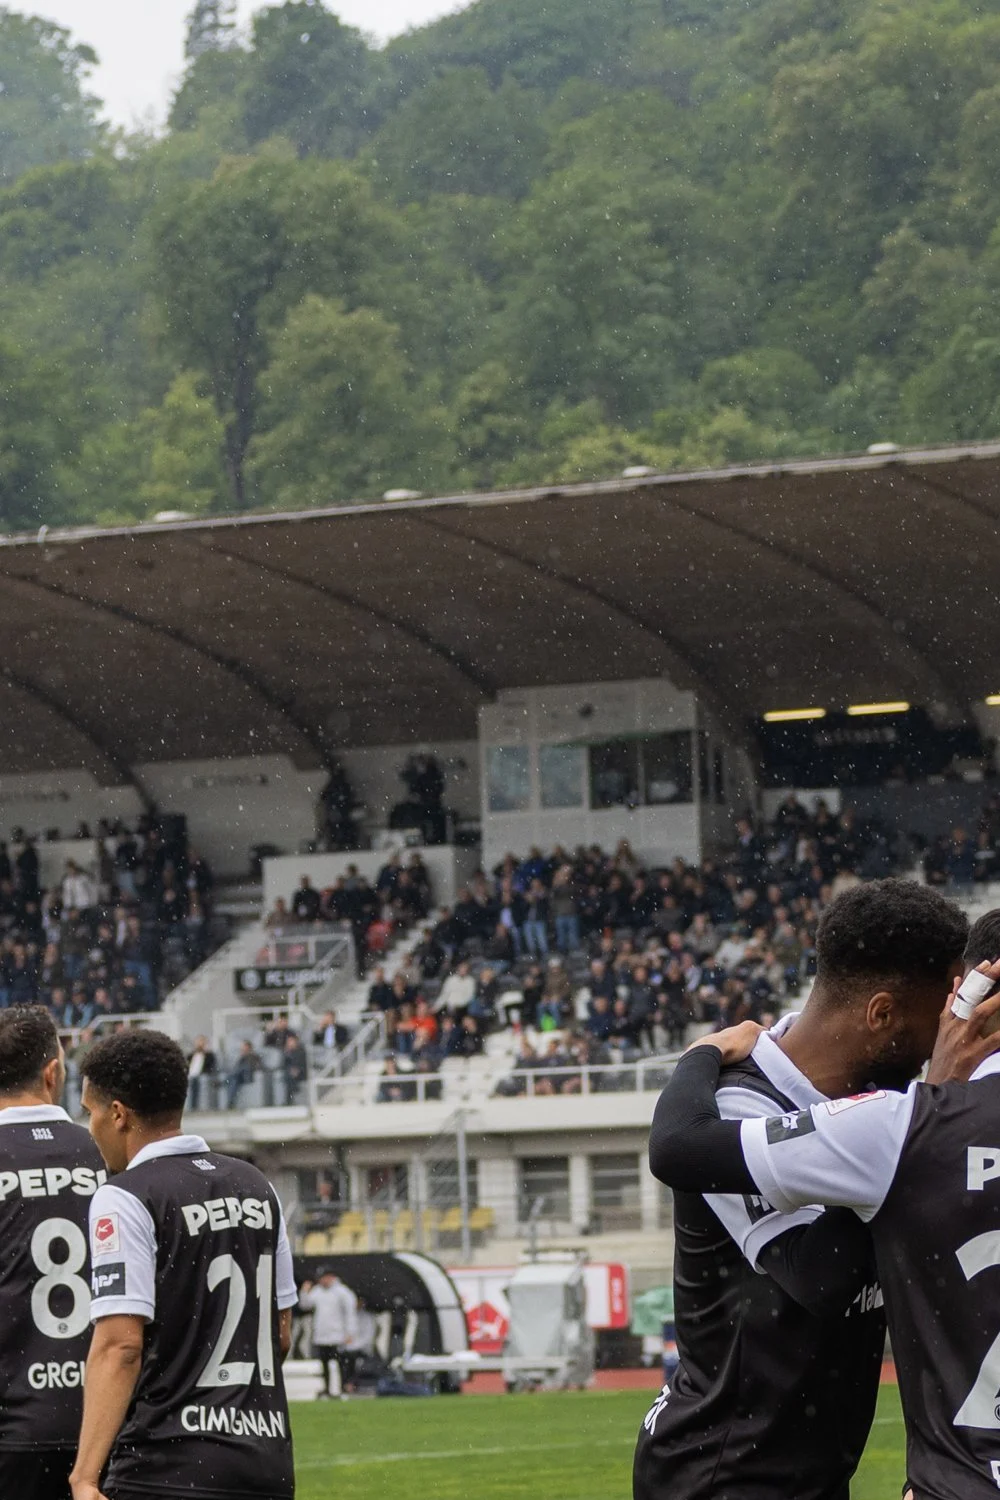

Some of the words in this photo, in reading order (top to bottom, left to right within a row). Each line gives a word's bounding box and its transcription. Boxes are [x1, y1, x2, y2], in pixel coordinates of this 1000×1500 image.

[0, 1167, 107, 1200] PEPSI
[181, 1197, 273, 1237] PEPSI
[31, 1217, 91, 1339] 8
[196, 1254, 275, 1387] 21
